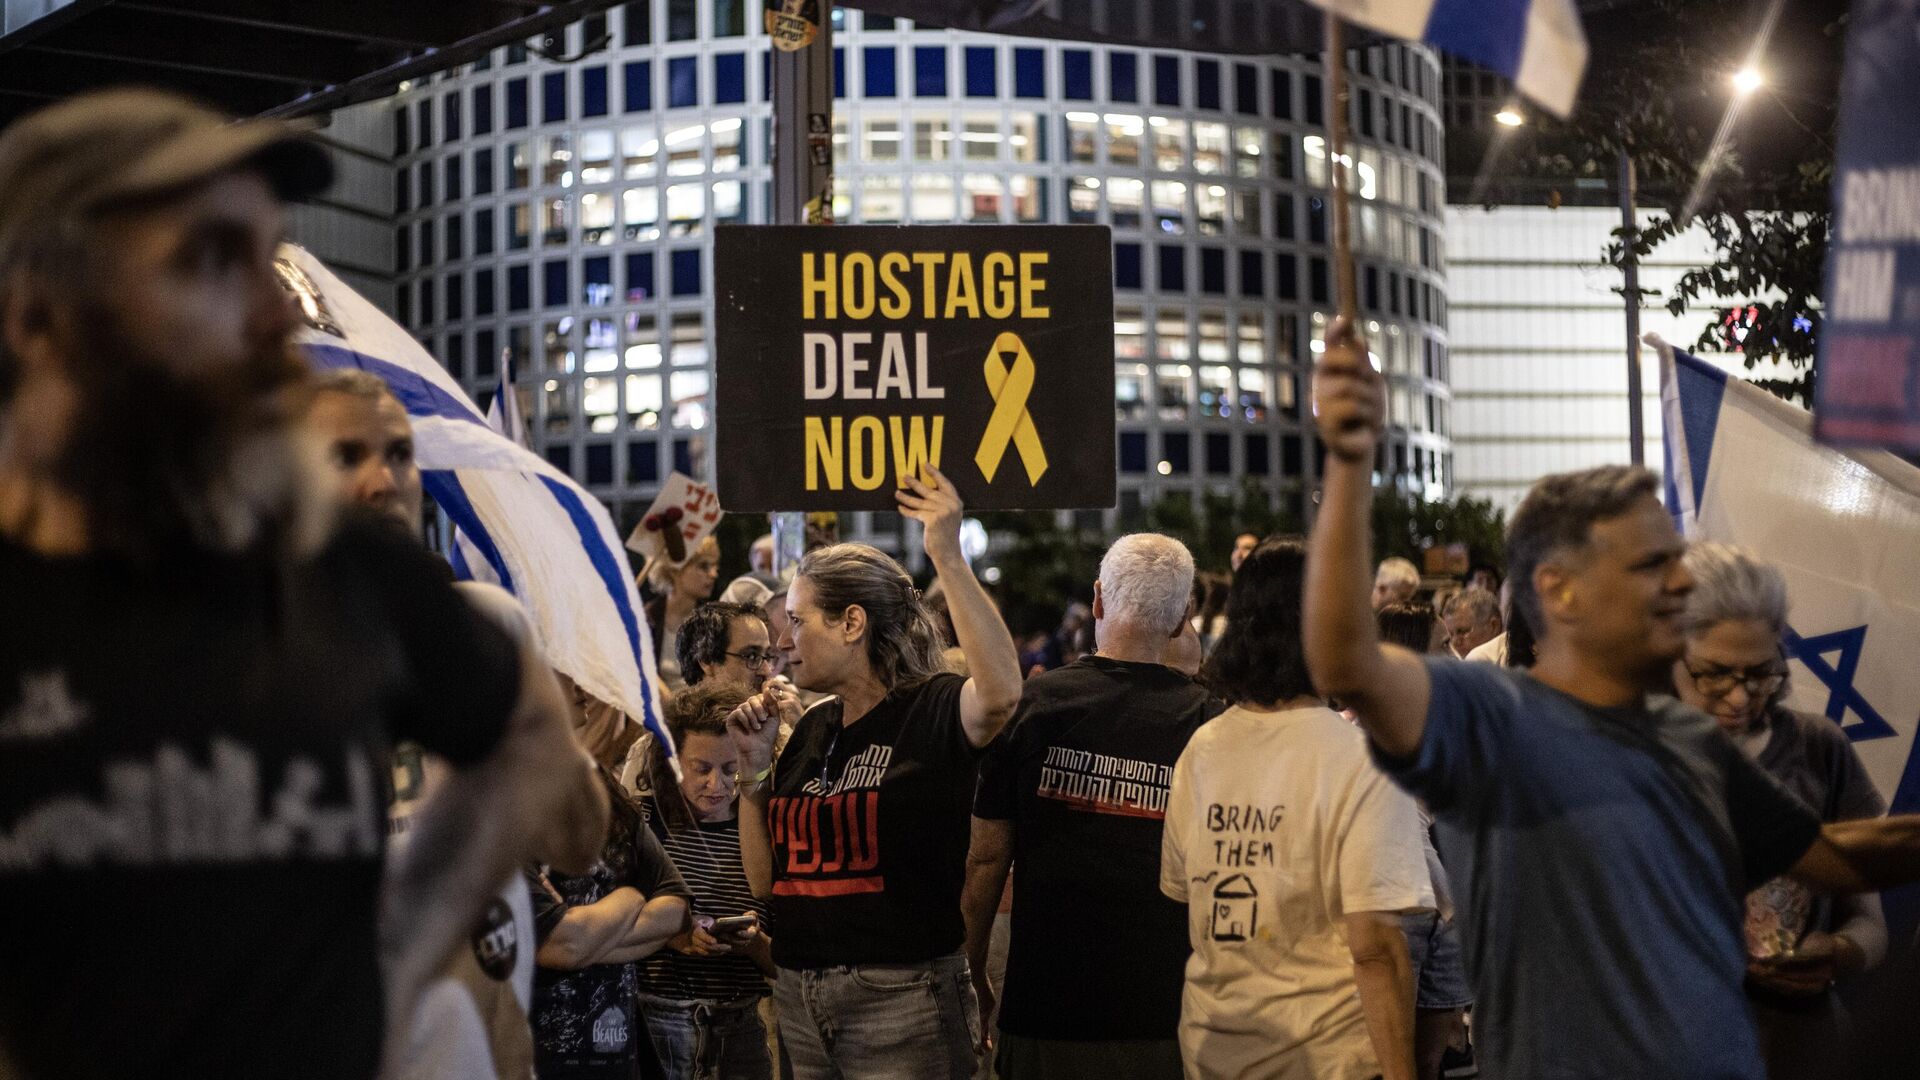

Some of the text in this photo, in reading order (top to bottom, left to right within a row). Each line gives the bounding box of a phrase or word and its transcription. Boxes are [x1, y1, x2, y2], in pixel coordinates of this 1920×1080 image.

[802, 251, 1050, 320] HOSTAGE
[803, 331, 946, 400] DEAL
[804, 415, 945, 491] NOW
[1043, 746, 1092, 772] להחזרת
[1091, 753, 1157, 784] המשפחות
[843, 765, 886, 791] אותם
[1039, 766, 1111, 804] והנעדרים
[768, 791, 879, 873] עכשיו
[1207, 803, 1286, 834] BRING
[1214, 839, 1274, 868] THEM
